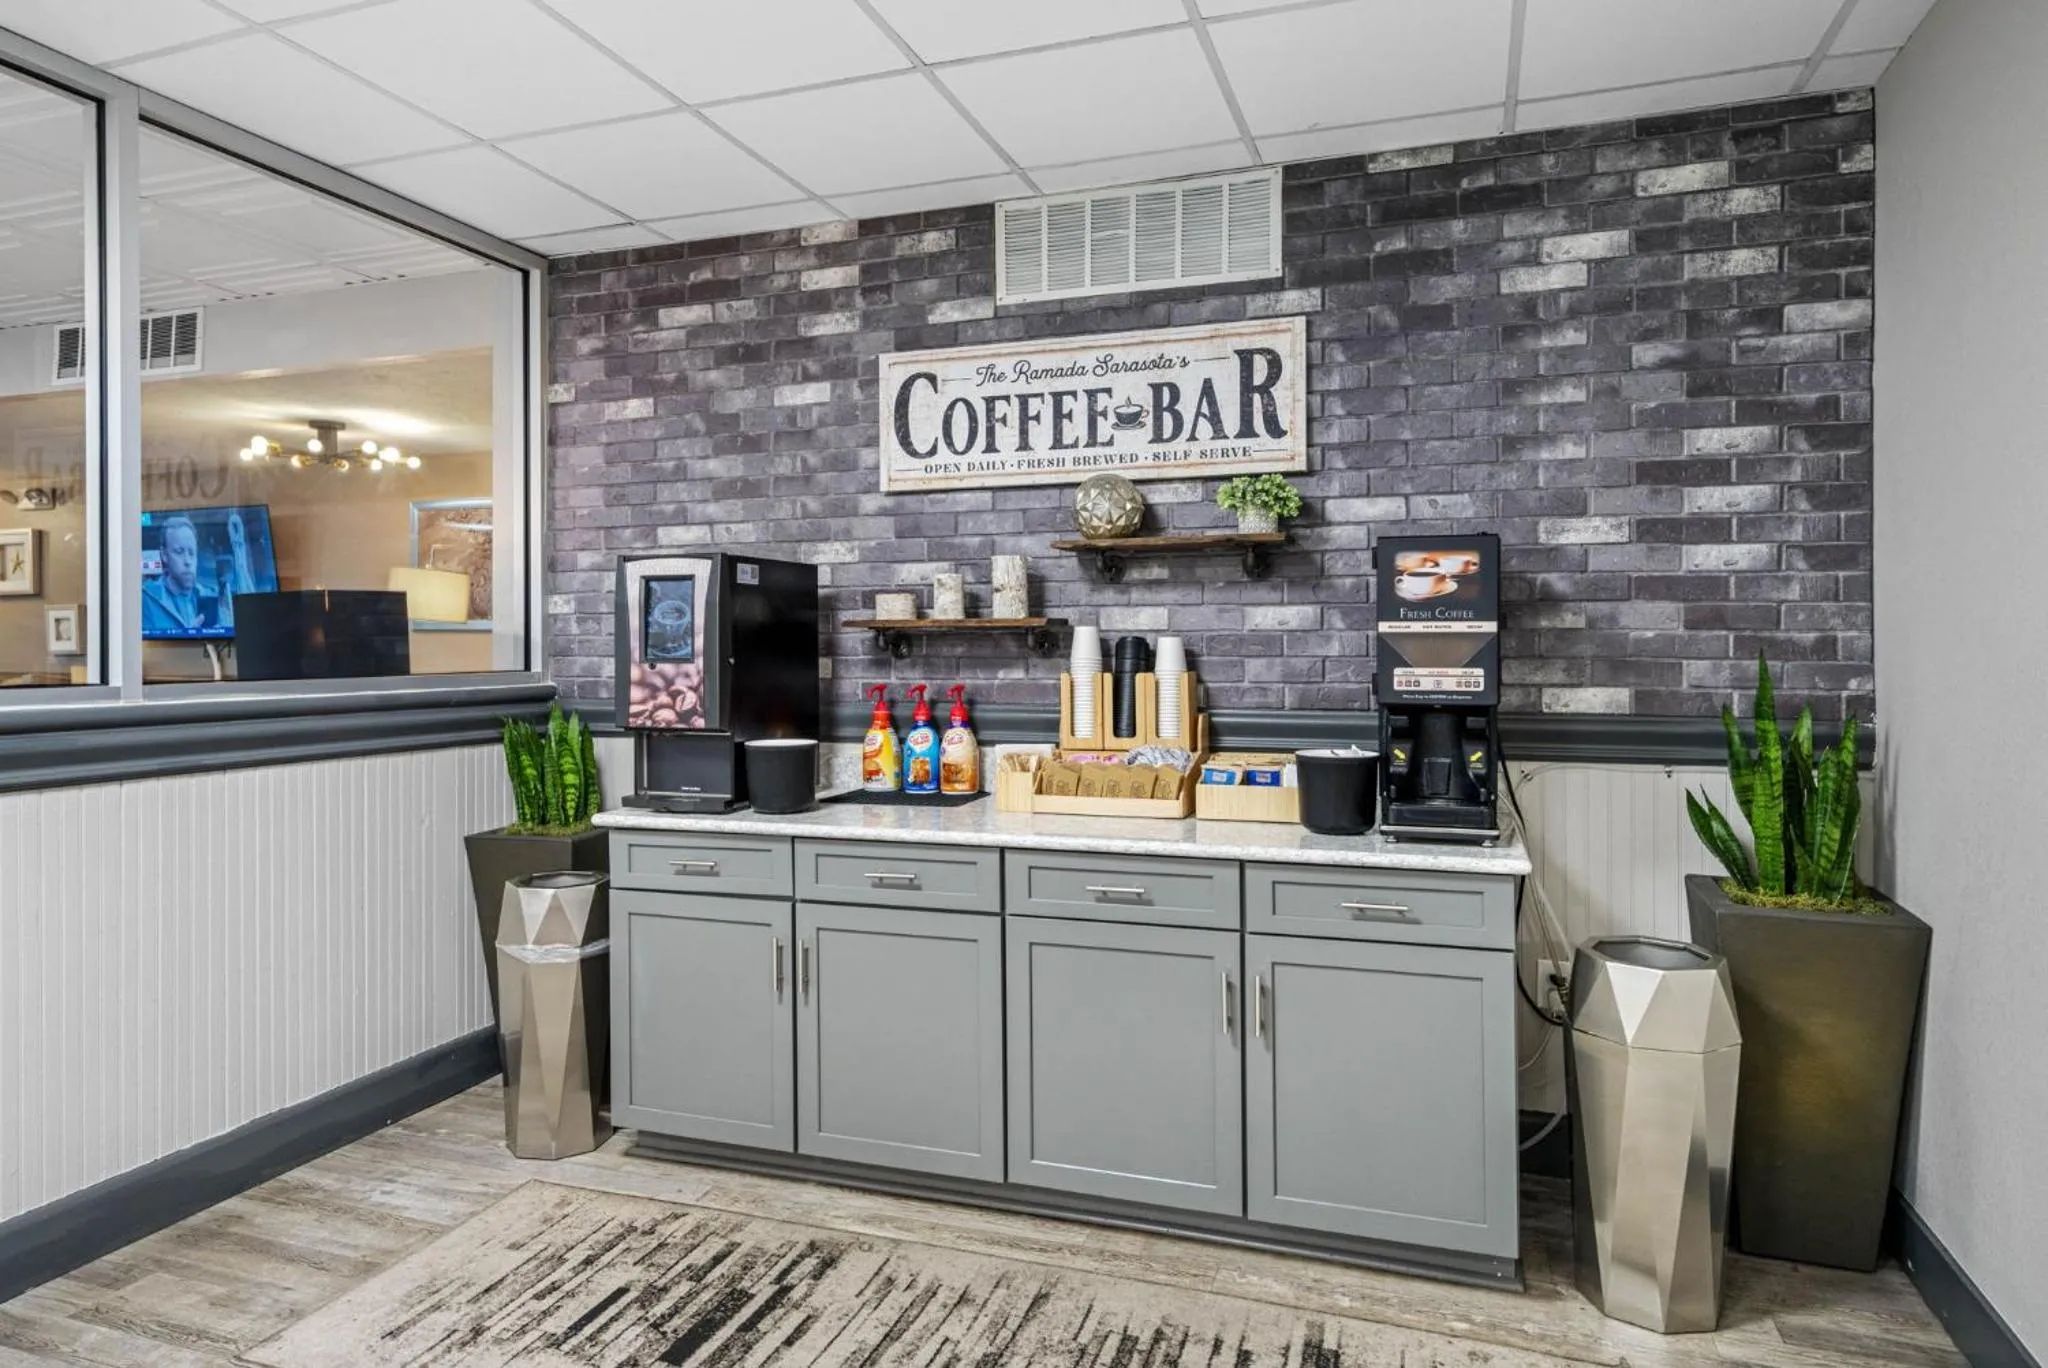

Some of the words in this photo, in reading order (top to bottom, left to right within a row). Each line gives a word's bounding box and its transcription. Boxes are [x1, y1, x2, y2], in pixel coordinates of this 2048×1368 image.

[976, 363, 1007, 387] The
[1011, 359, 1089, 385] Ramada
[1093, 353, 1190, 377] Sarasota's
[894, 371, 1115, 460] COFFEE
[1147, 347, 1288, 445] BAR
[924, 463, 962, 474] OPEN
[967, 459, 1006, 472] DAILY
[1017, 456, 1066, 469] FRESH
[1072, 451, 1139, 467] BREWED
[1151, 449, 1194, 462] SELF
[1200, 446, 1252, 459] SERVE
[1400, 607, 1431, 619] FRESH
[1435, 606, 1475, 619] COFFEE
